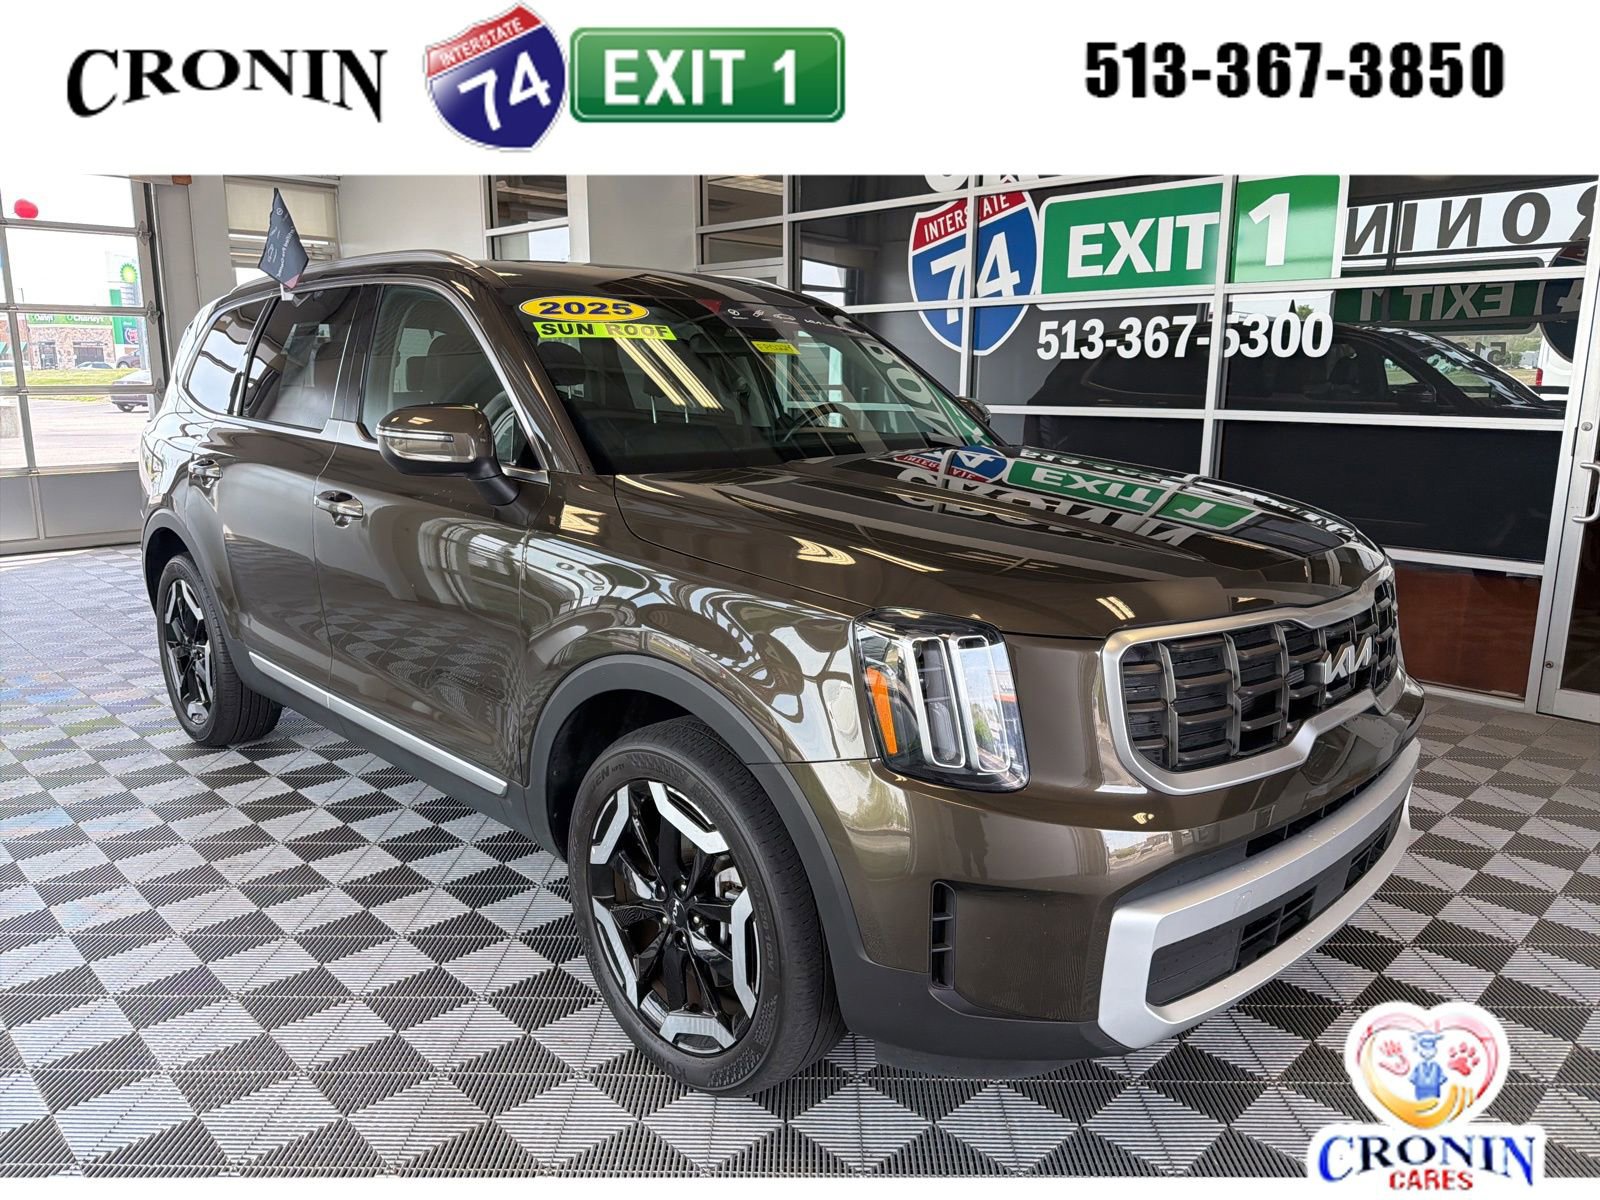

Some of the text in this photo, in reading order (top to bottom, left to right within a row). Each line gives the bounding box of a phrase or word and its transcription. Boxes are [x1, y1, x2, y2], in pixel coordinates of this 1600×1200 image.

[1067, 193, 1291, 279] EXIT 1
[930, 231, 1021, 325] 74
[538, 301, 634, 316] 2025
[540, 323, 669, 337] SUN ROOF
[1036, 311, 1334, 361] 513-367-5300
